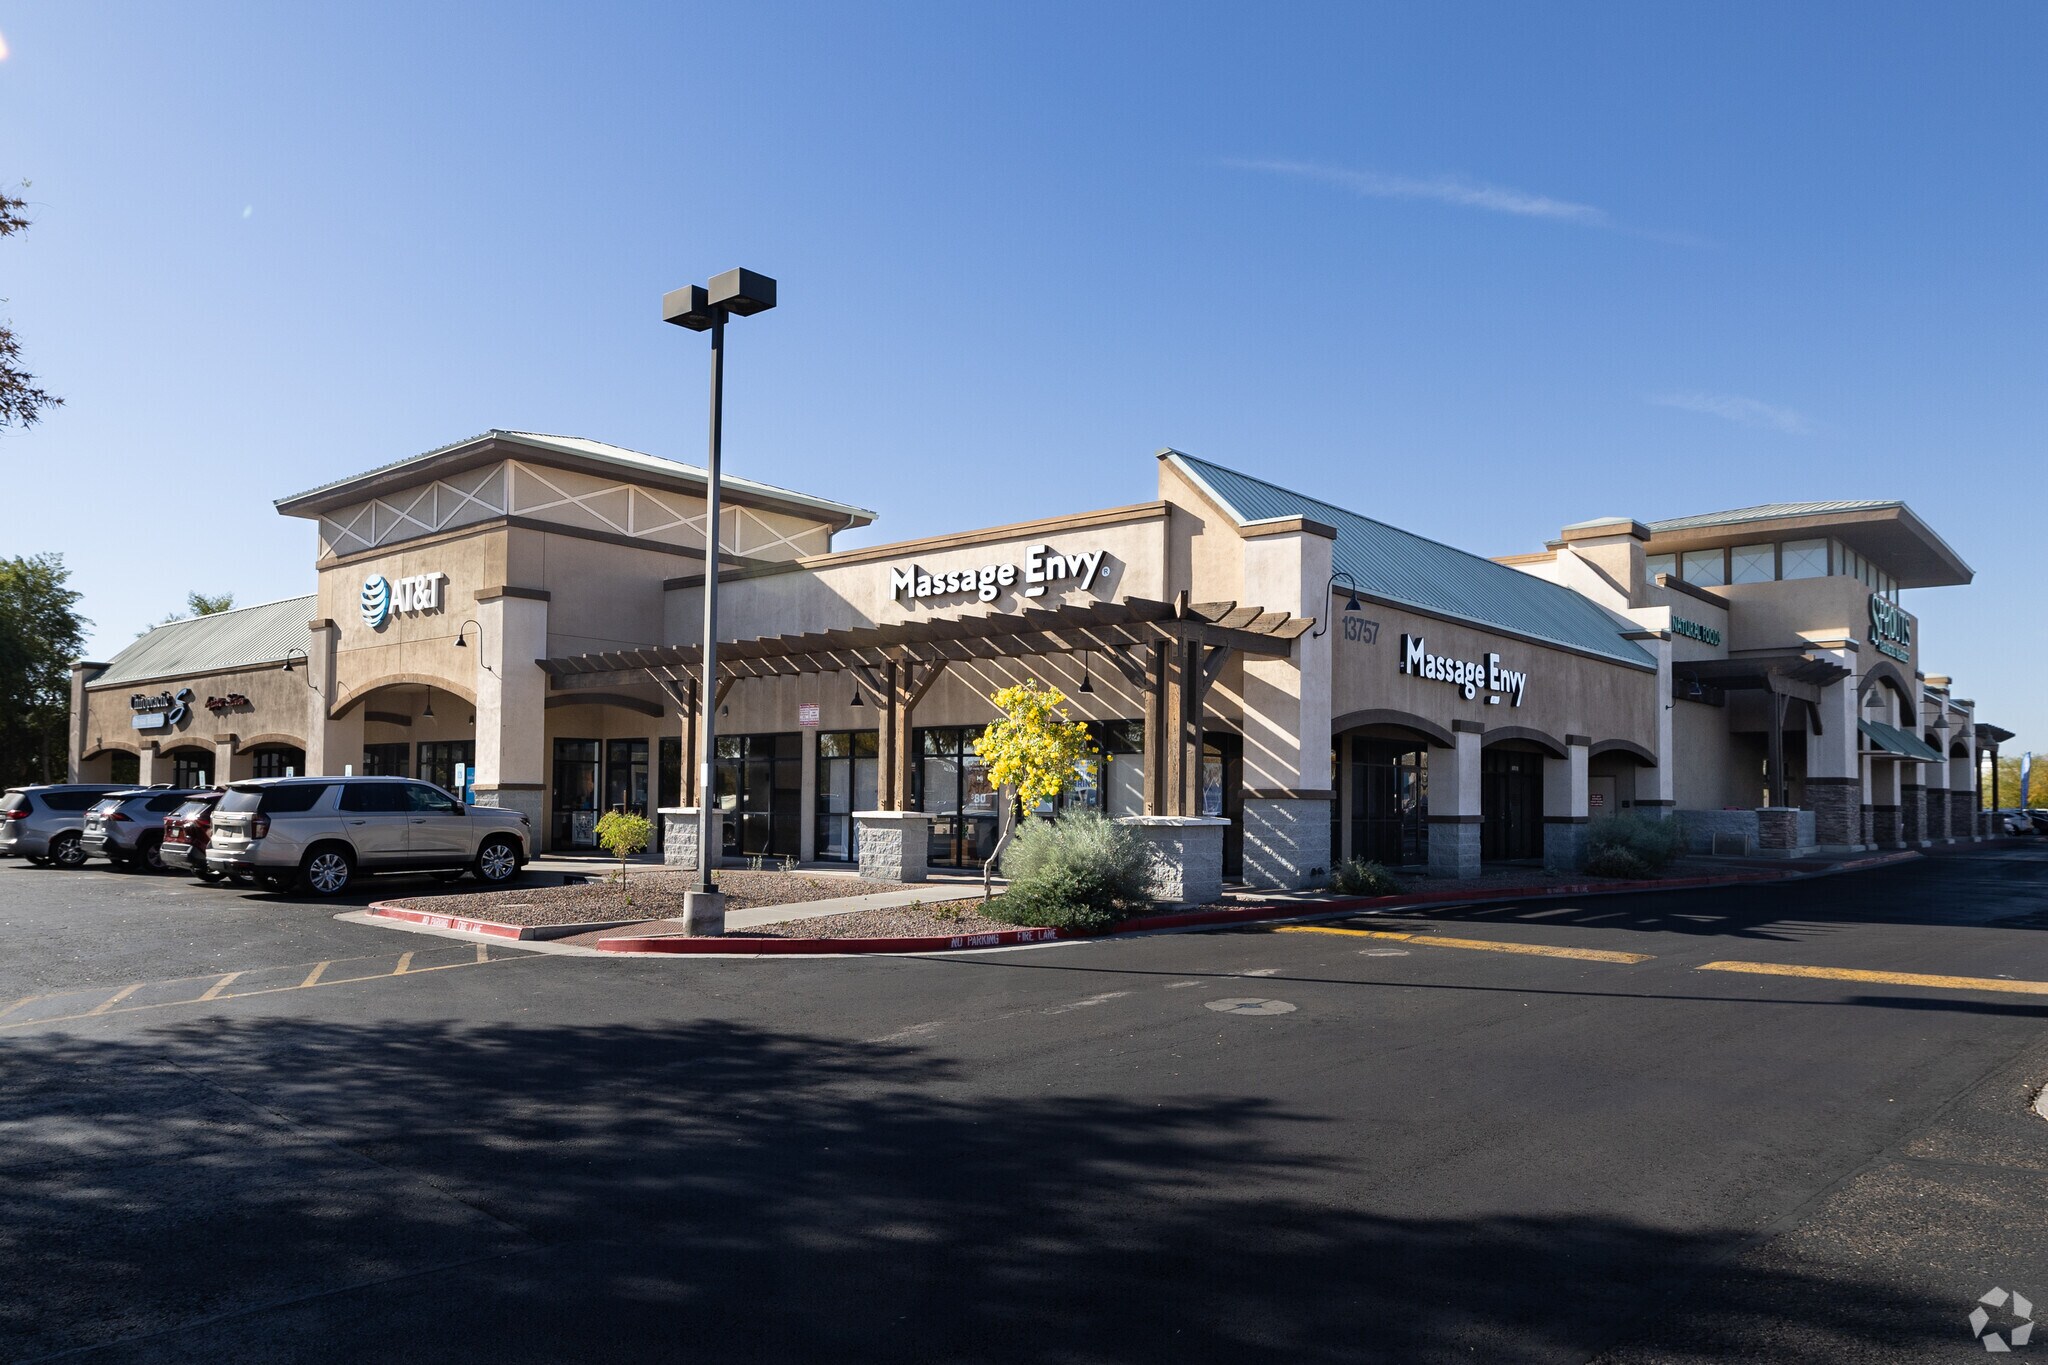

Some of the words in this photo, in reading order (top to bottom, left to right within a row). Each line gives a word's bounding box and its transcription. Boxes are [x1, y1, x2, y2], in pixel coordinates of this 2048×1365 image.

[388, 572, 444, 614] AT&T
[890, 563, 1016, 602] Massage
[1342, 616, 1379, 645] 13757
[1403, 633, 1485, 700] Massage
[1487, 652, 1526, 707] Envy
[951, 937, 963, 948] NO
[967, 934, 999, 946] PARKING
[1017, 930, 1034, 941] FIRE
[1038, 929, 1058, 940] LANE
